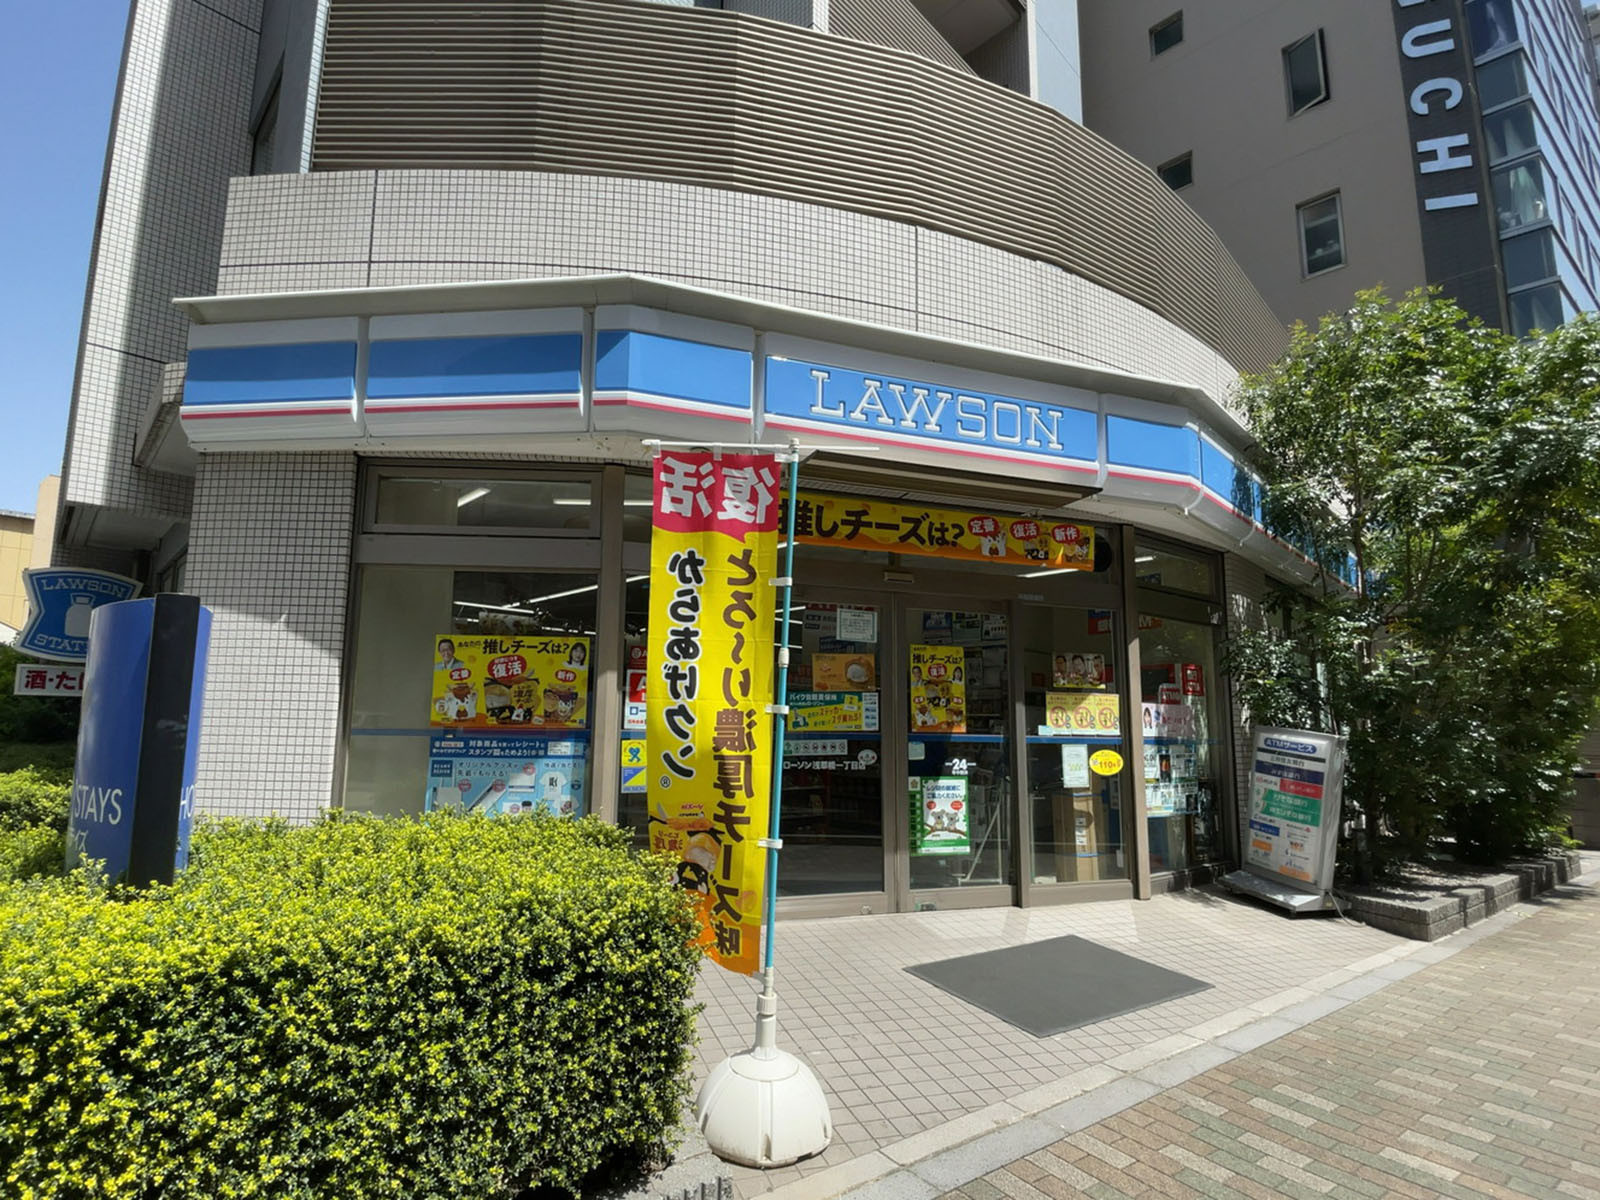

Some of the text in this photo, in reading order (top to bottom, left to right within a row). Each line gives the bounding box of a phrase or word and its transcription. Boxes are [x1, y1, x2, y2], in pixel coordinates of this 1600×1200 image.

[1397, 0, 1479, 211] UCHI
[809, 367, 1065, 451] LAWSON
[1013, 522, 1038, 538] 復活
[1054, 525, 1079, 543] 新作
[41, 578, 127, 597] LAWSON
[492, 661, 522, 678] 復活
[1265, 739, 1314, 753] ATMサービス
[952, 758, 968, 770] 24
